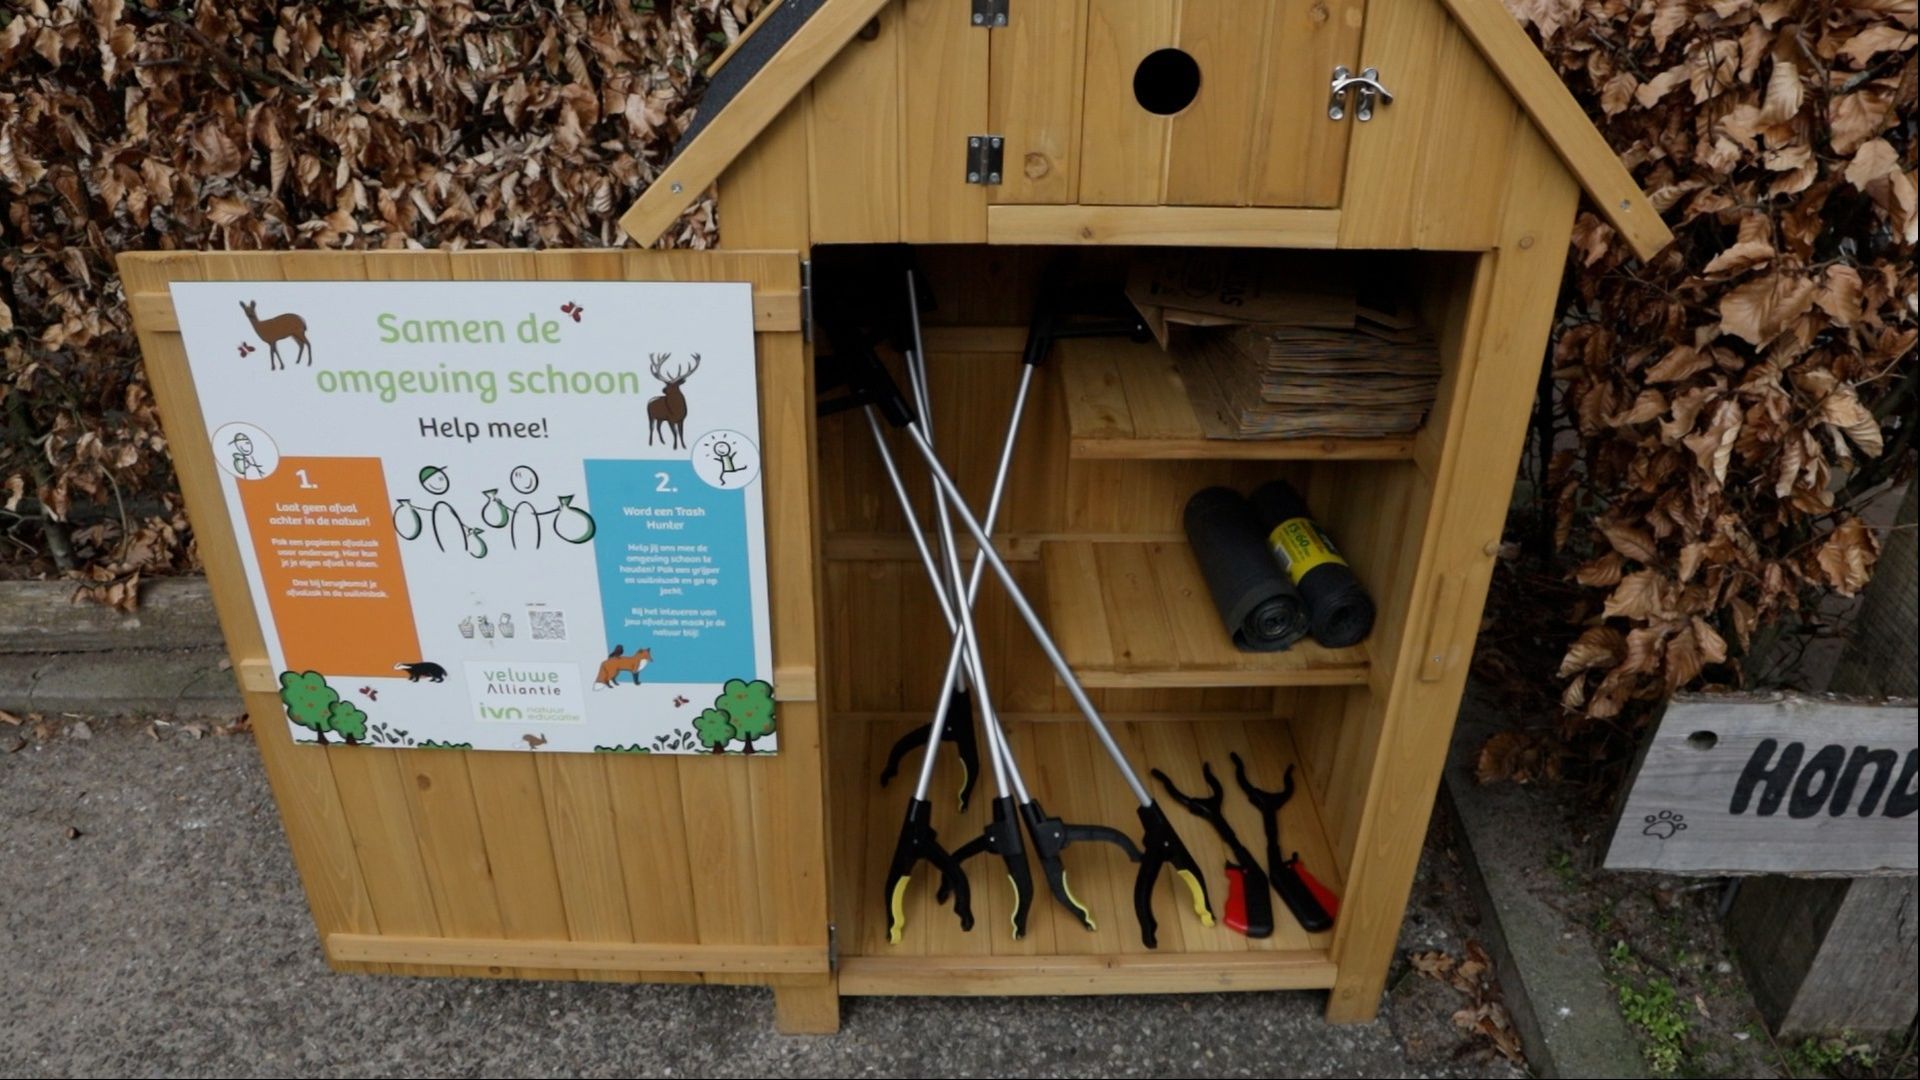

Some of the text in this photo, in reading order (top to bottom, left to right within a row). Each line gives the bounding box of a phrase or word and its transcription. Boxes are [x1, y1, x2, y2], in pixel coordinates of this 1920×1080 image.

[376, 312, 562, 344] Samen de
[316, 363, 640, 404] omgeving schoon
[418, 416, 549, 443] Help mee!
[296, 469, 318, 489] 1.
[654, 471, 678, 492] 2.
[276, 502, 358, 515] Laat geen afval
[623, 507, 706, 517] Word een Trash
[269, 516, 371, 526] achter in de natuur!
[646, 520, 684, 530] Hunter
[483, 667, 559, 683] veluwe
[487, 683, 561, 696] Alliantie
[479, 702, 523, 719] ivn
